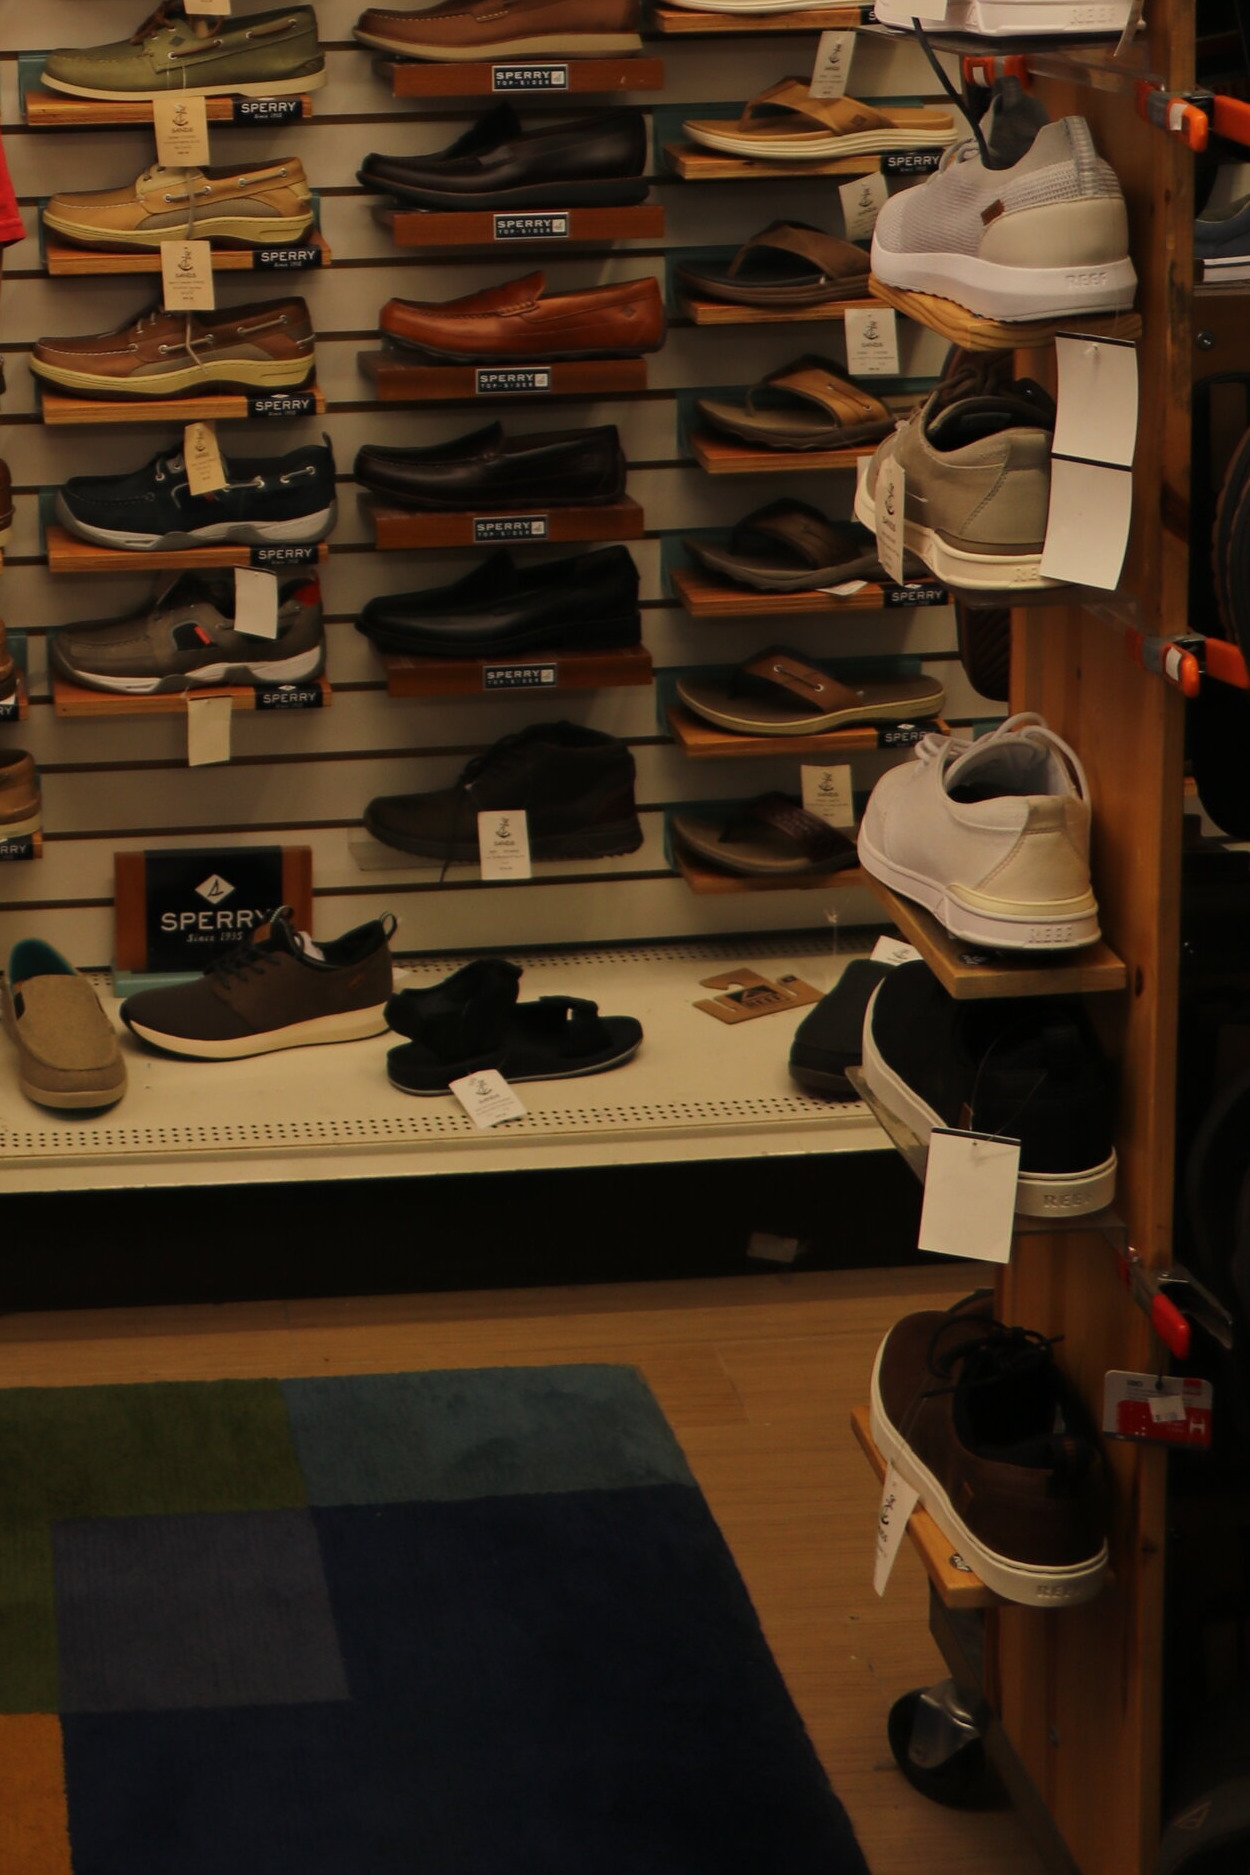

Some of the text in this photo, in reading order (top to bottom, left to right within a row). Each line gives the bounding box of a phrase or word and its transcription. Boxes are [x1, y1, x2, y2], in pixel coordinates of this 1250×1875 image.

[495, 70, 550, 80] SPERRY
[240, 101, 297, 114] SPERRY
[887, 155, 940, 167] SPERRY
[497, 218, 552, 229] SPERRY
[260, 249, 316, 262] SPERRY
[1065, 271, 1107, 288] REEF
[479, 373, 534, 383] SPERRY
[255, 398, 311, 411] SPERRY
[477, 521, 530, 532] SPERRY
[257, 547, 313, 560] SPERRY
[891, 589, 943, 602] SPERRY
[486, 669, 540, 680] SPERRY
[263, 691, 318, 704] SPERRY
[160, 909, 274, 931] SPERRY
[186, 933, 215, 943] Since
